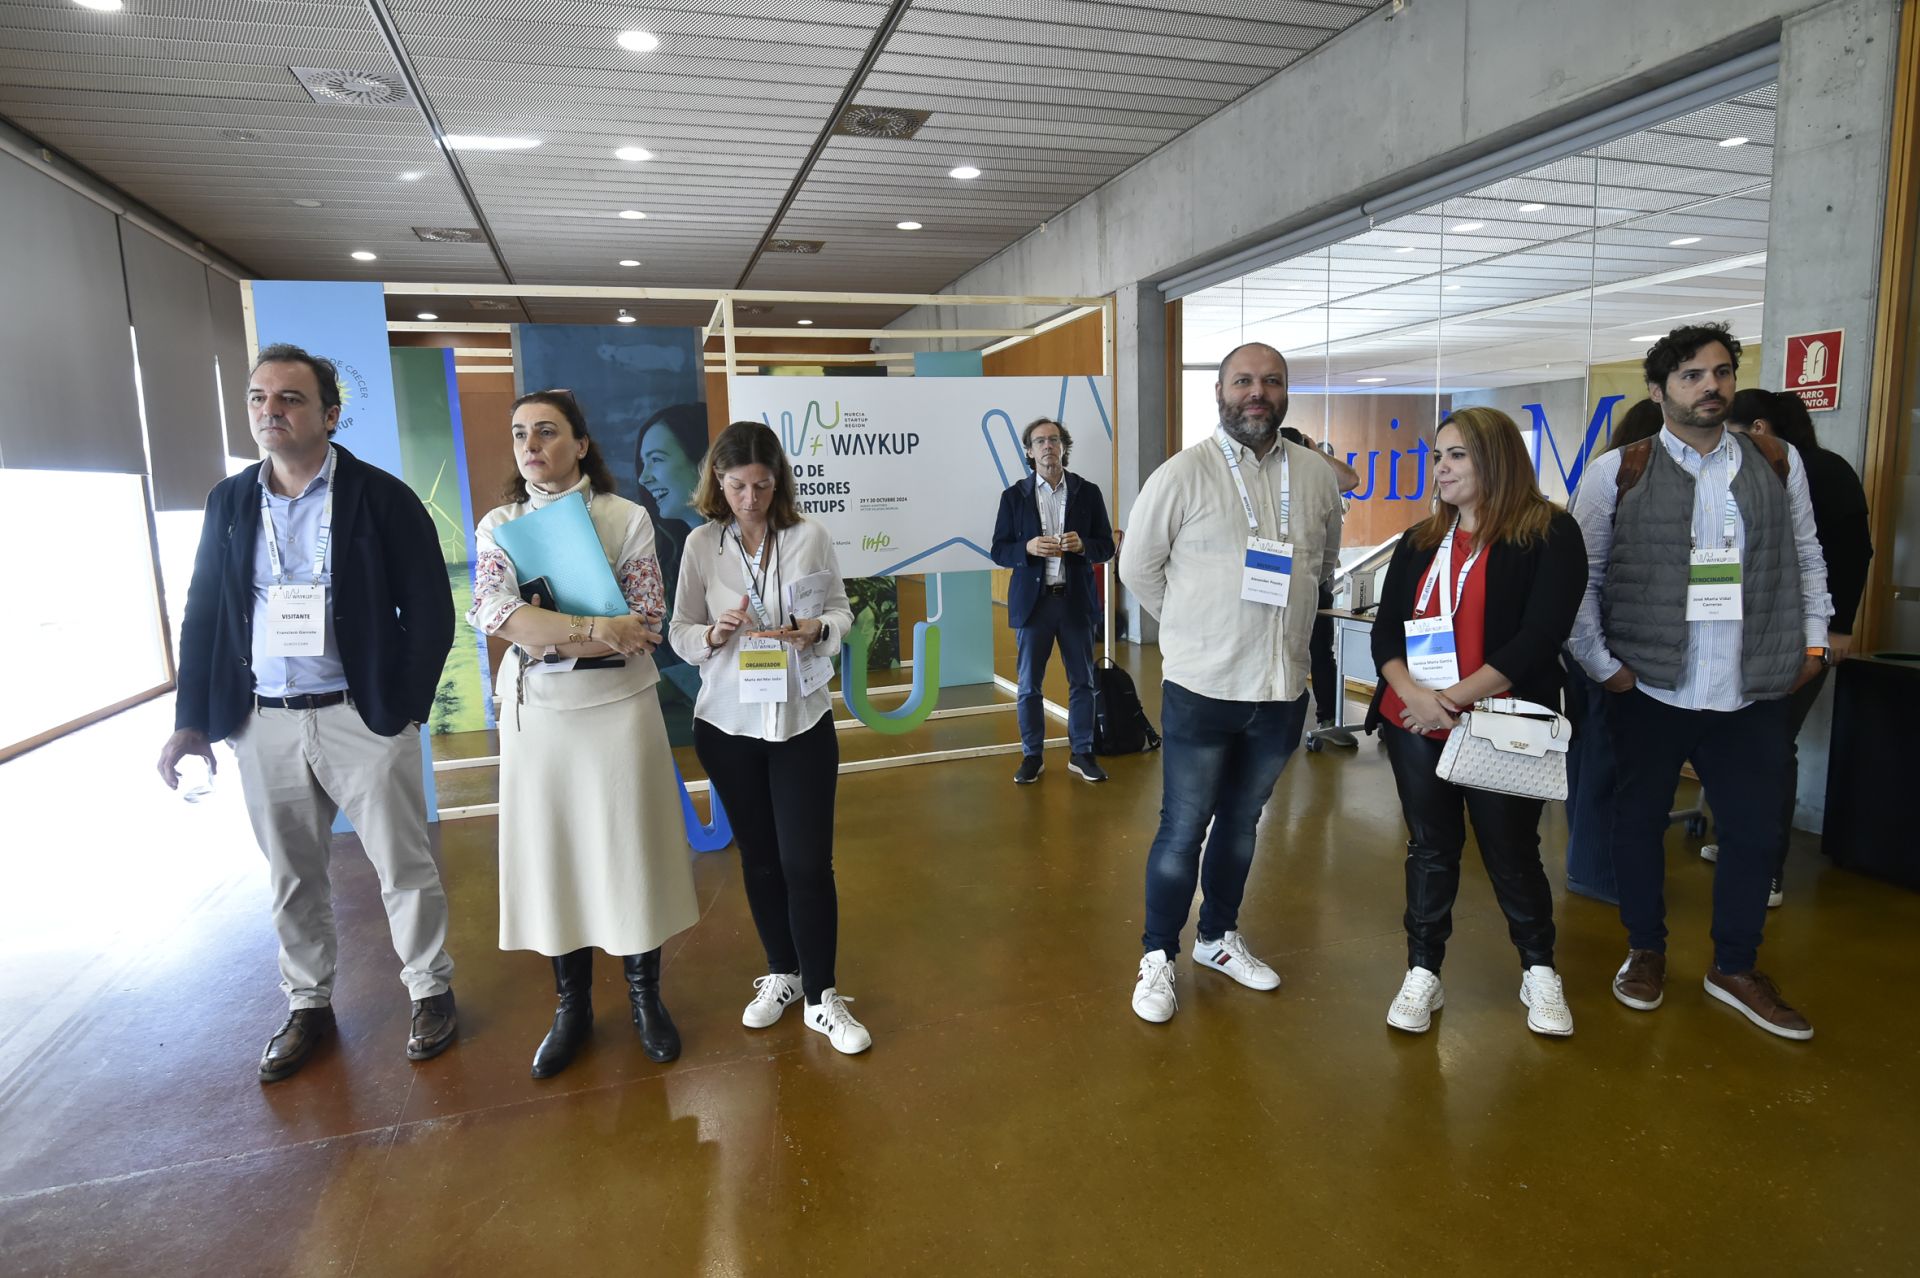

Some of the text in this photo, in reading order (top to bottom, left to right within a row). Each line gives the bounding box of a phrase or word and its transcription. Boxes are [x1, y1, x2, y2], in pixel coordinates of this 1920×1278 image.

[330, 358, 368, 399] DE CRECER
[1797, 390, 1824, 399] ARRO
[1804, 398, 1829, 407] NTOR
[830, 433, 920, 456] WAYKUP
[807, 464, 825, 477] DE
[795, 482, 850, 496] ERSORES
[795, 500, 845, 514] ARTUPS
[862, 531, 890, 552] info
